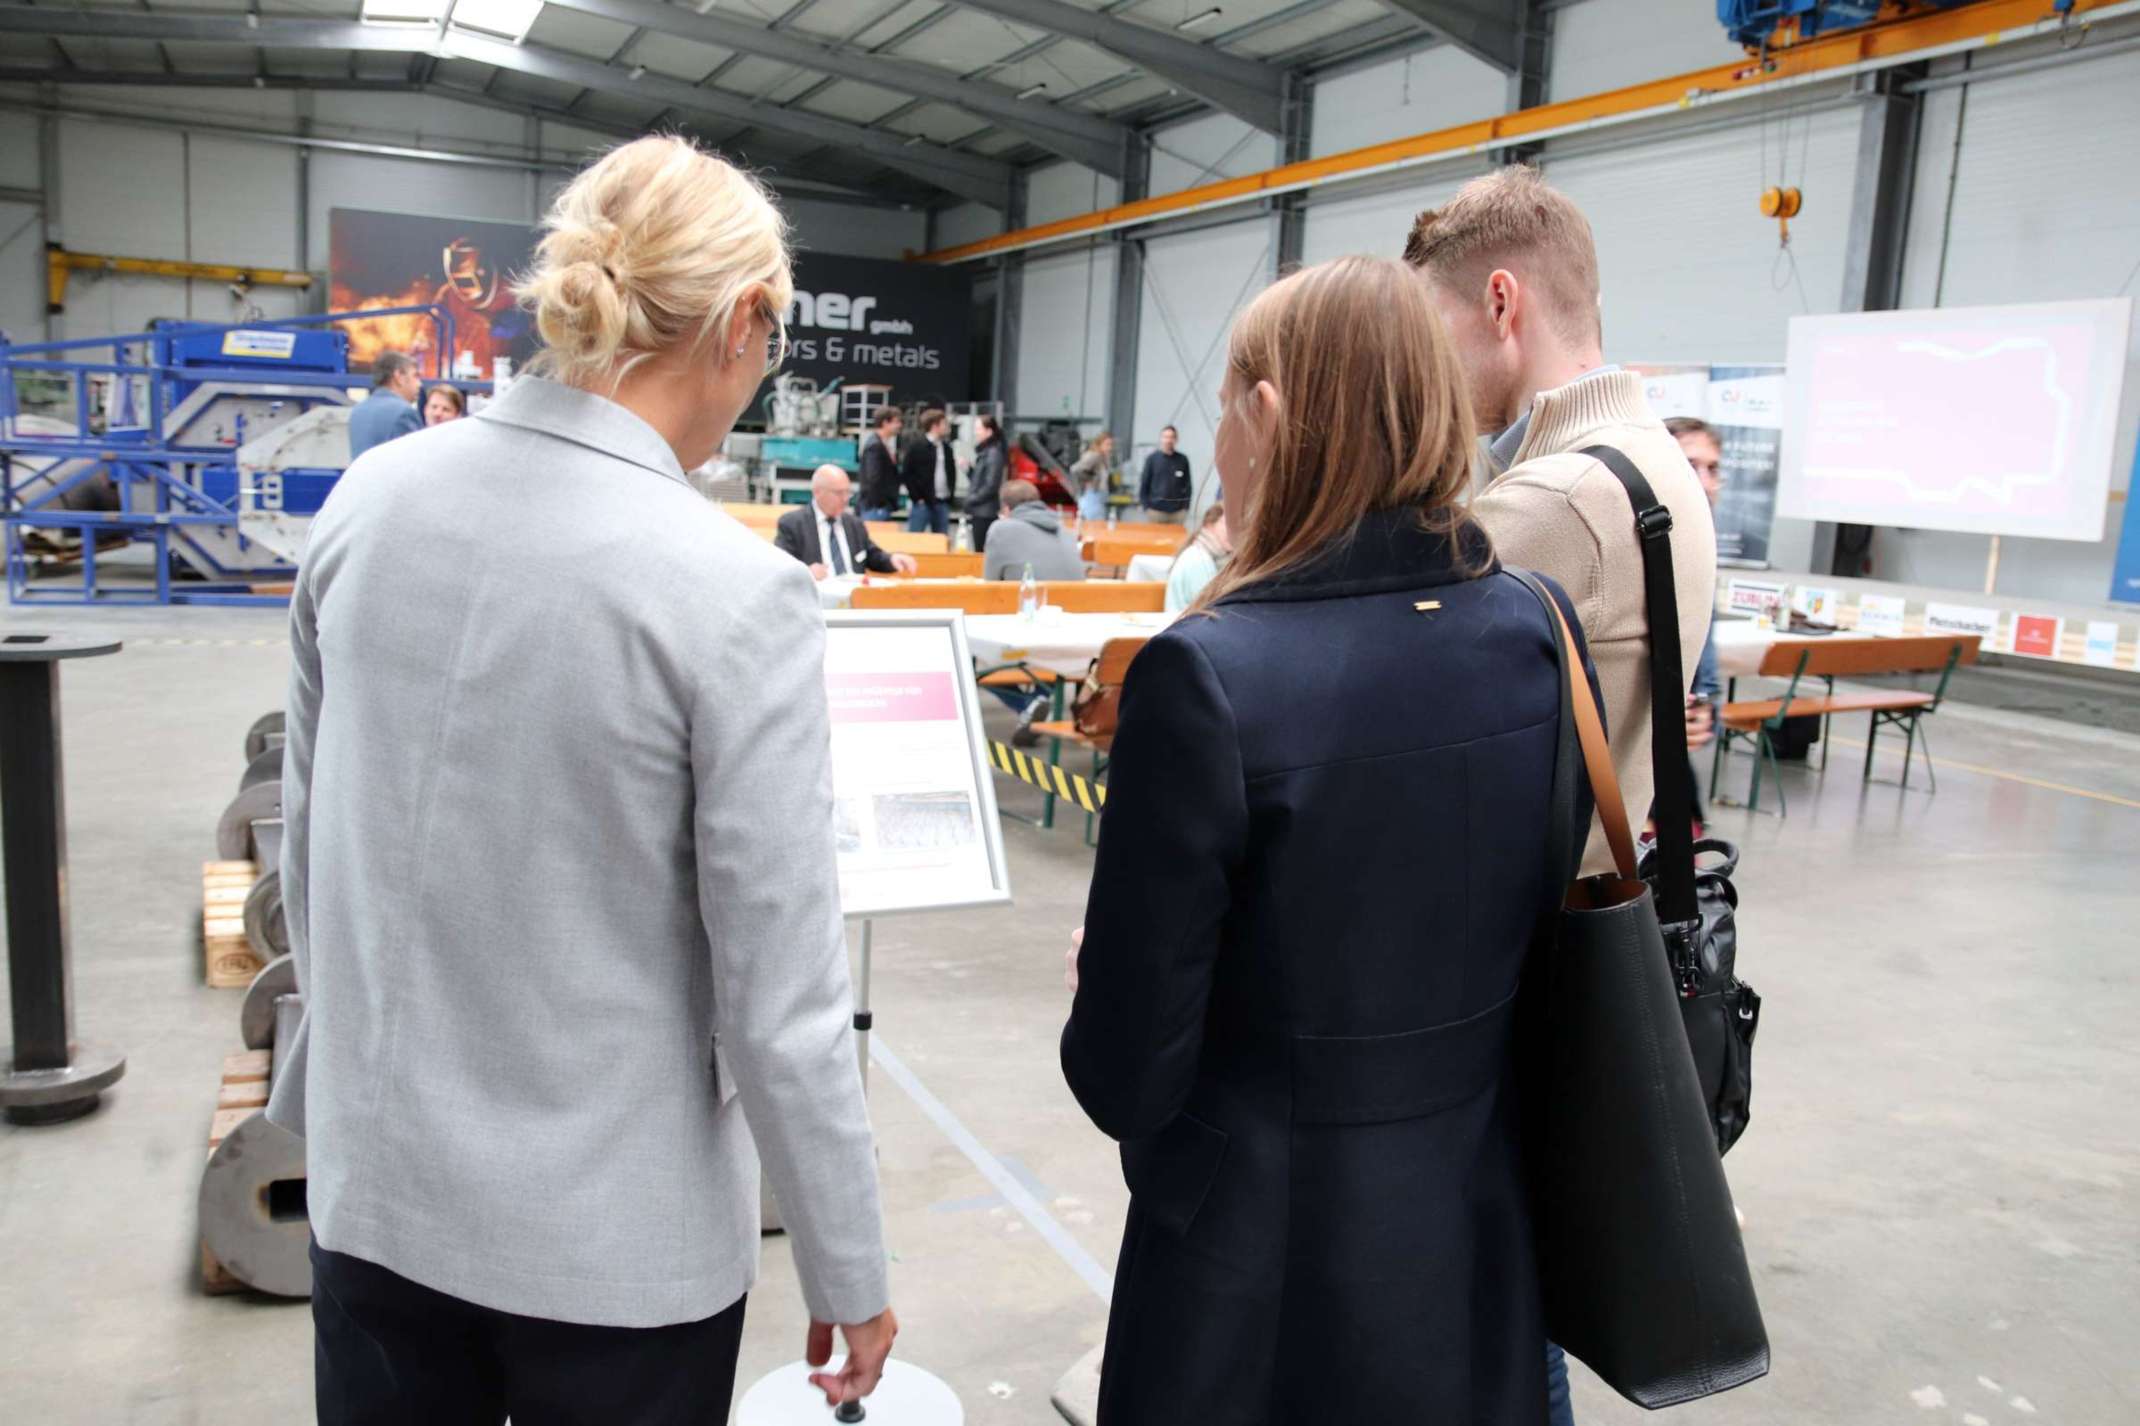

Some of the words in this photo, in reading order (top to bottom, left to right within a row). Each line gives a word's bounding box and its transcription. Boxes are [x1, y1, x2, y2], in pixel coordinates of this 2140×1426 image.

[785, 290, 876, 331] ner
[870, 319, 913, 335] gmbh
[779, 338, 817, 361] ors
[825, 337, 845, 362] &
[853, 343, 940, 370] metals
